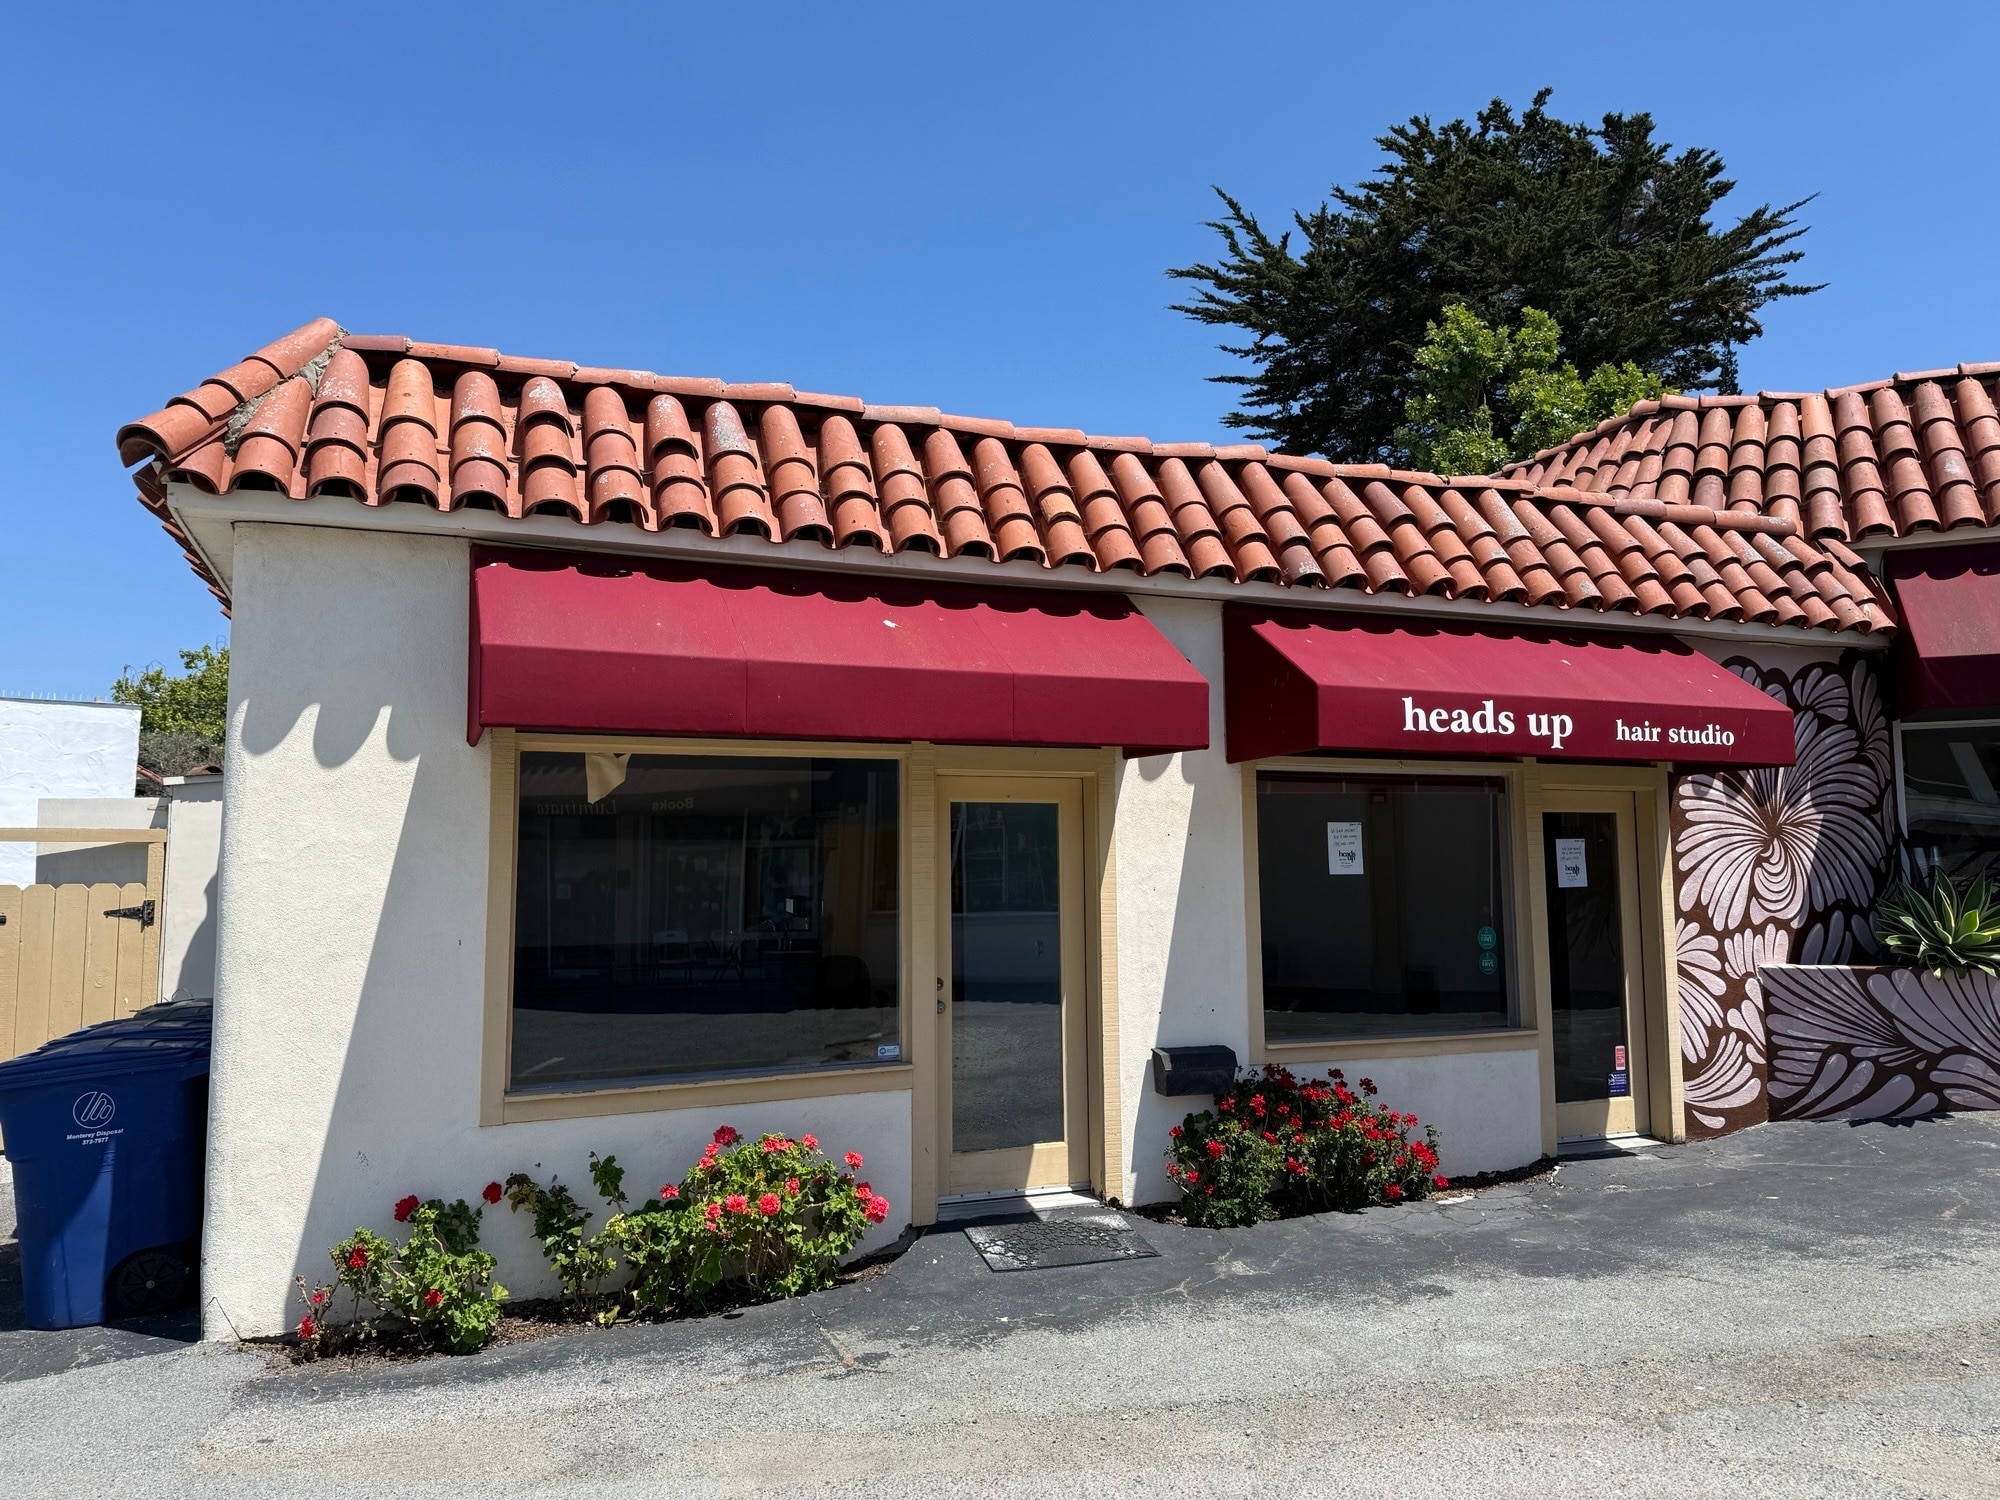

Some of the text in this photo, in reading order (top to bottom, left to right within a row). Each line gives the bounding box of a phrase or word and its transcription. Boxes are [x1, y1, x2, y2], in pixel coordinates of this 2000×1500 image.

[1401, 696, 1735, 750] heads up hair studio
[66, 1128, 124, 1140] Monterey Disposal
